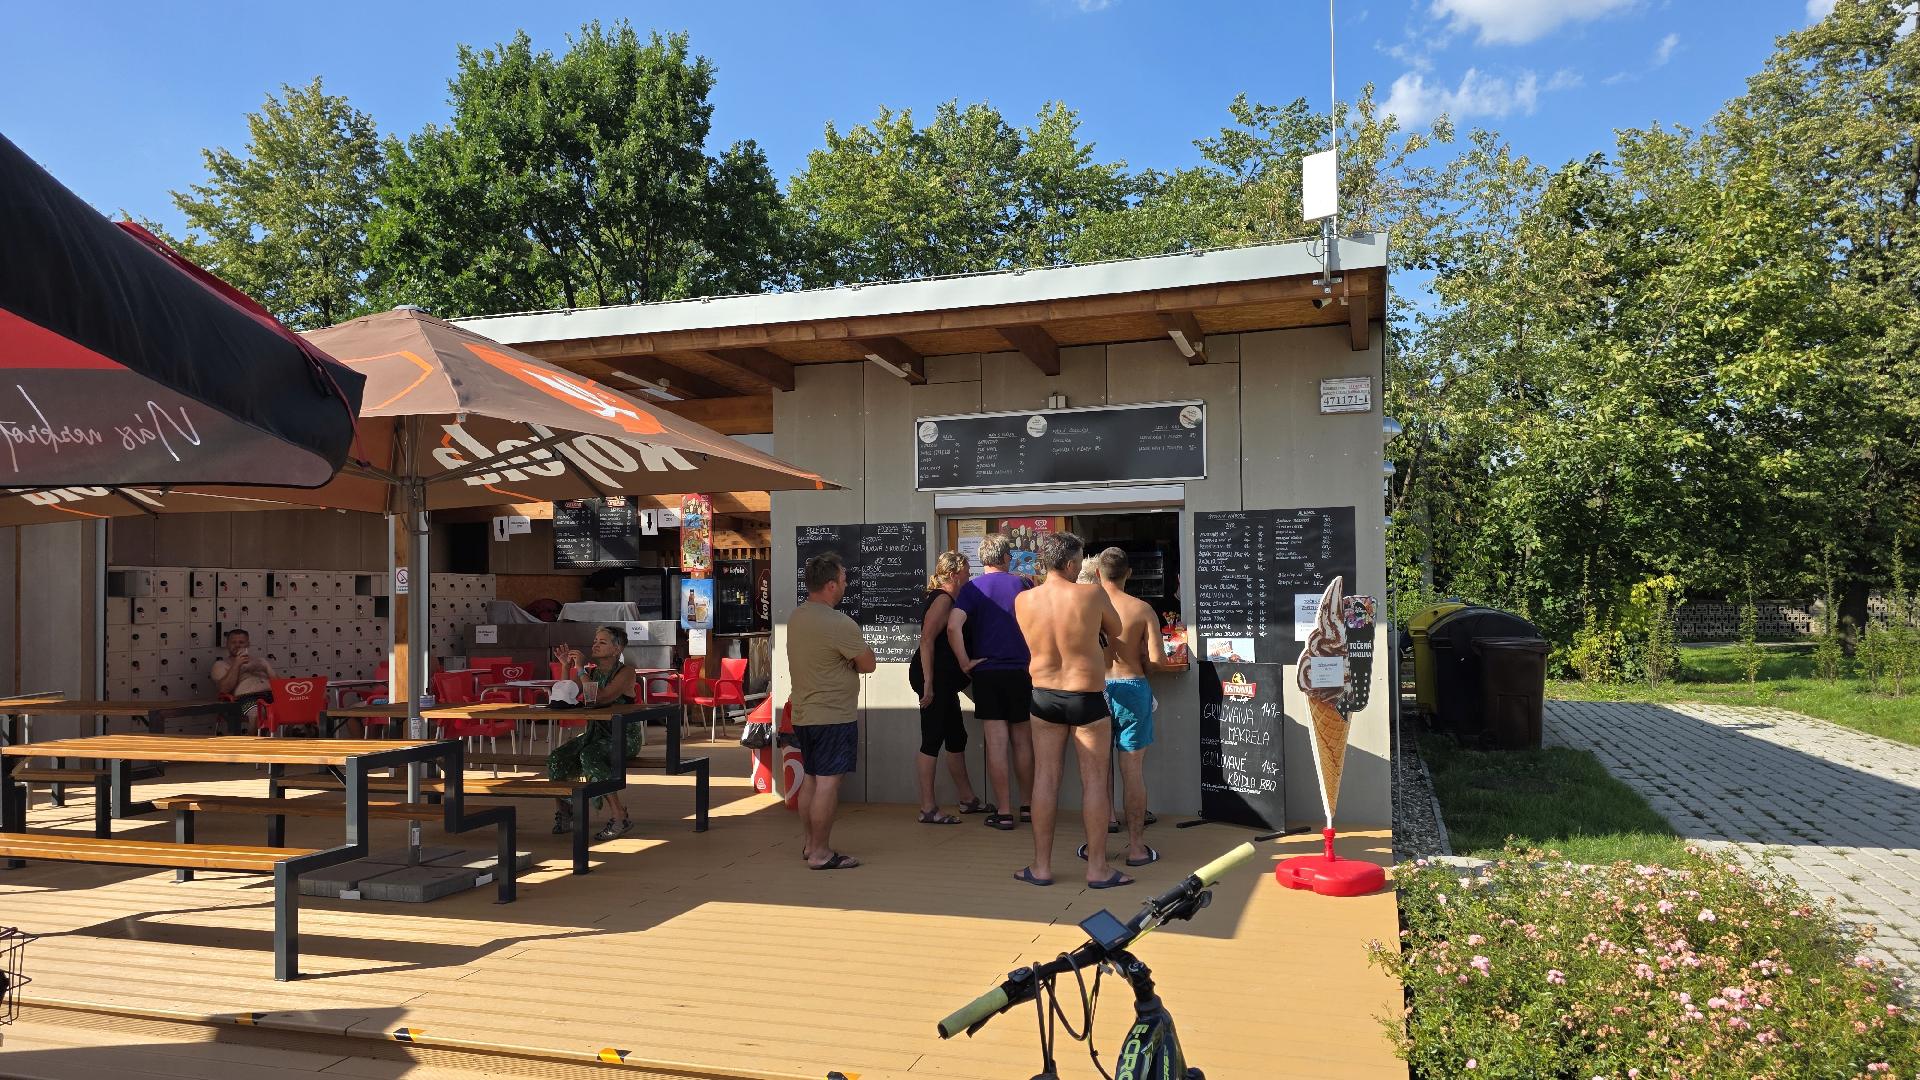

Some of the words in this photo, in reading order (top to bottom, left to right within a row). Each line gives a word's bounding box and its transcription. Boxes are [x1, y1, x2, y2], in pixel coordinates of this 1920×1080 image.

[760, 579, 770, 621] kofola
[1349, 640, 1373, 650] TOČENÁ
[1228, 726, 1270, 747] MAKRELA
[1227, 771, 1256, 789] KŘÍDLA
